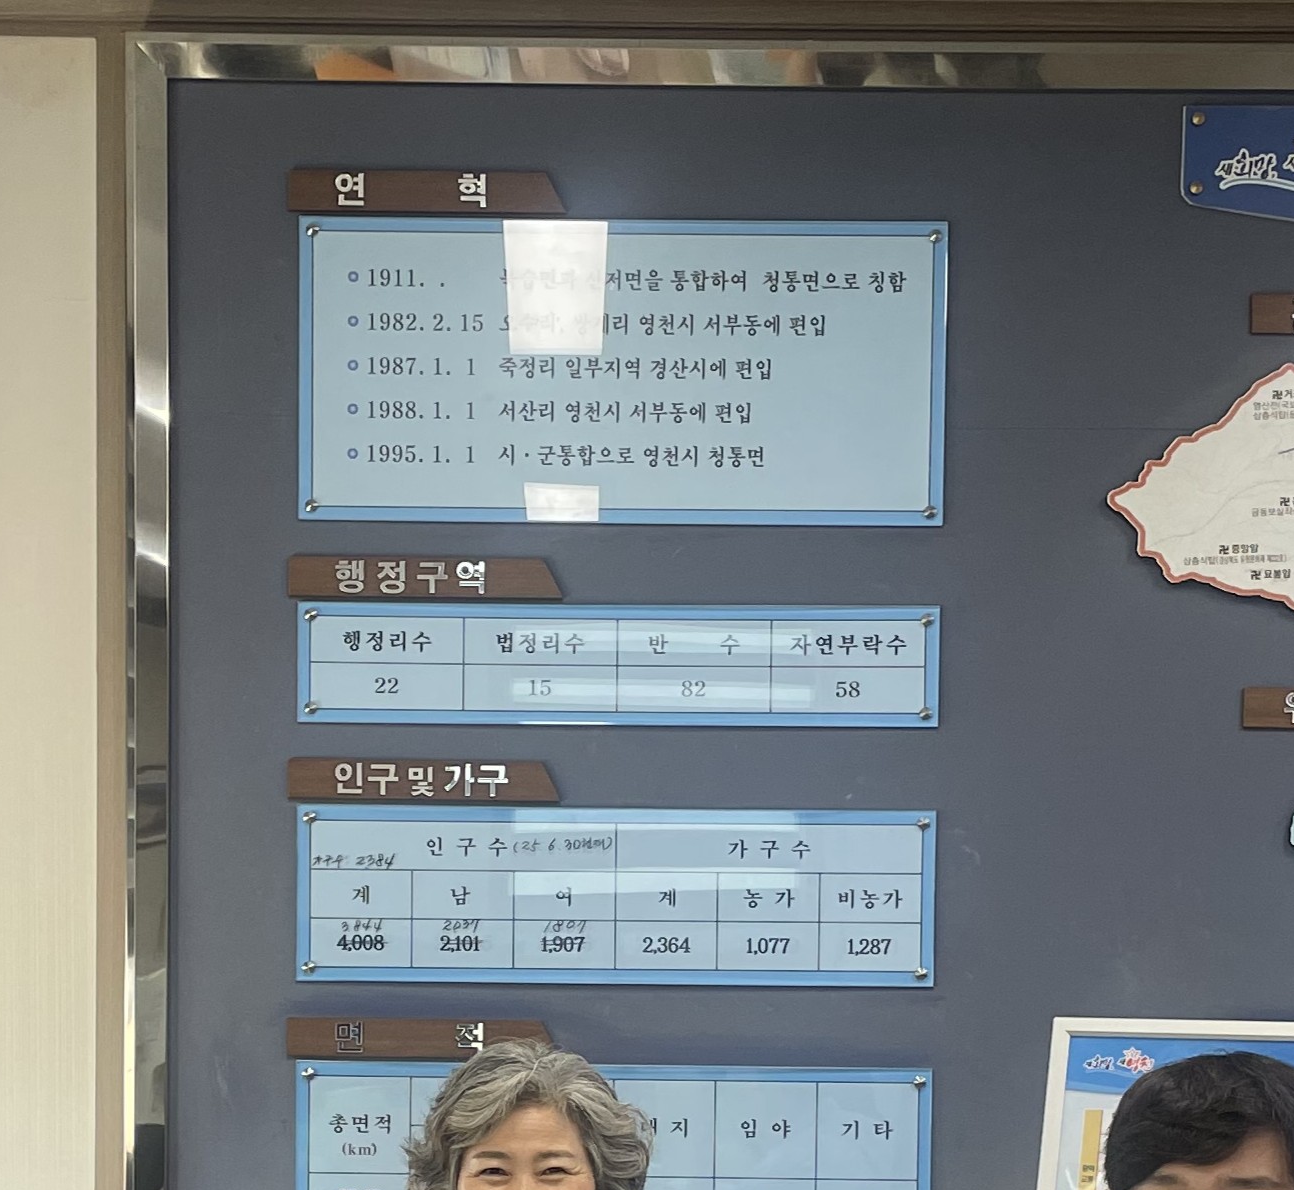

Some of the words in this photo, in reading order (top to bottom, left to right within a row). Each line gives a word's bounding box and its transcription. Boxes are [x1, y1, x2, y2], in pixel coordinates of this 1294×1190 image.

[670, 269, 748, 292] 통합하여
[762, 270, 861, 293] 청통면으로
[867, 270, 907, 293] 칭함
[639, 313, 695, 336] 영천시
[703, 313, 782, 336] 서부동에
[789, 314, 827, 337] 편입
[499, 356, 556, 380] 죽정리
[565, 357, 641, 381] 일부지역
[649, 357, 728, 381] 경산시에
[736, 358, 773, 381] 편입
[499, 400, 556, 424] 서산리
[565, 401, 621, 425] 영천시
[629, 401, 707, 425] 서부동에
[714, 402, 752, 426] 편입
[643, 445, 699, 468] 영천시
[708, 445, 766, 469] 청통면
[333, 560, 487, 595] 행정구역
[342, 630, 433, 652] 행정리수
[495, 631, 585, 655] 법정리수
[788, 633, 908, 657] 자연부락수
[373, 676, 400, 696] 22
[527, 678, 553, 698] 15
[680, 678, 707, 699] 82
[834, 679, 862, 700] 58
[352, 885, 370, 905] 계
[450, 885, 472, 906] 남
[555, 887, 572, 907] 여
[658, 888, 677, 908] 계
[837, 889, 903, 910] 비농가
[642, 936, 692, 957] 2,364
[745, 936, 790, 958] 1,077
[845, 937, 892, 958] 1,287
[329, 1112, 393, 1135] 총면적
